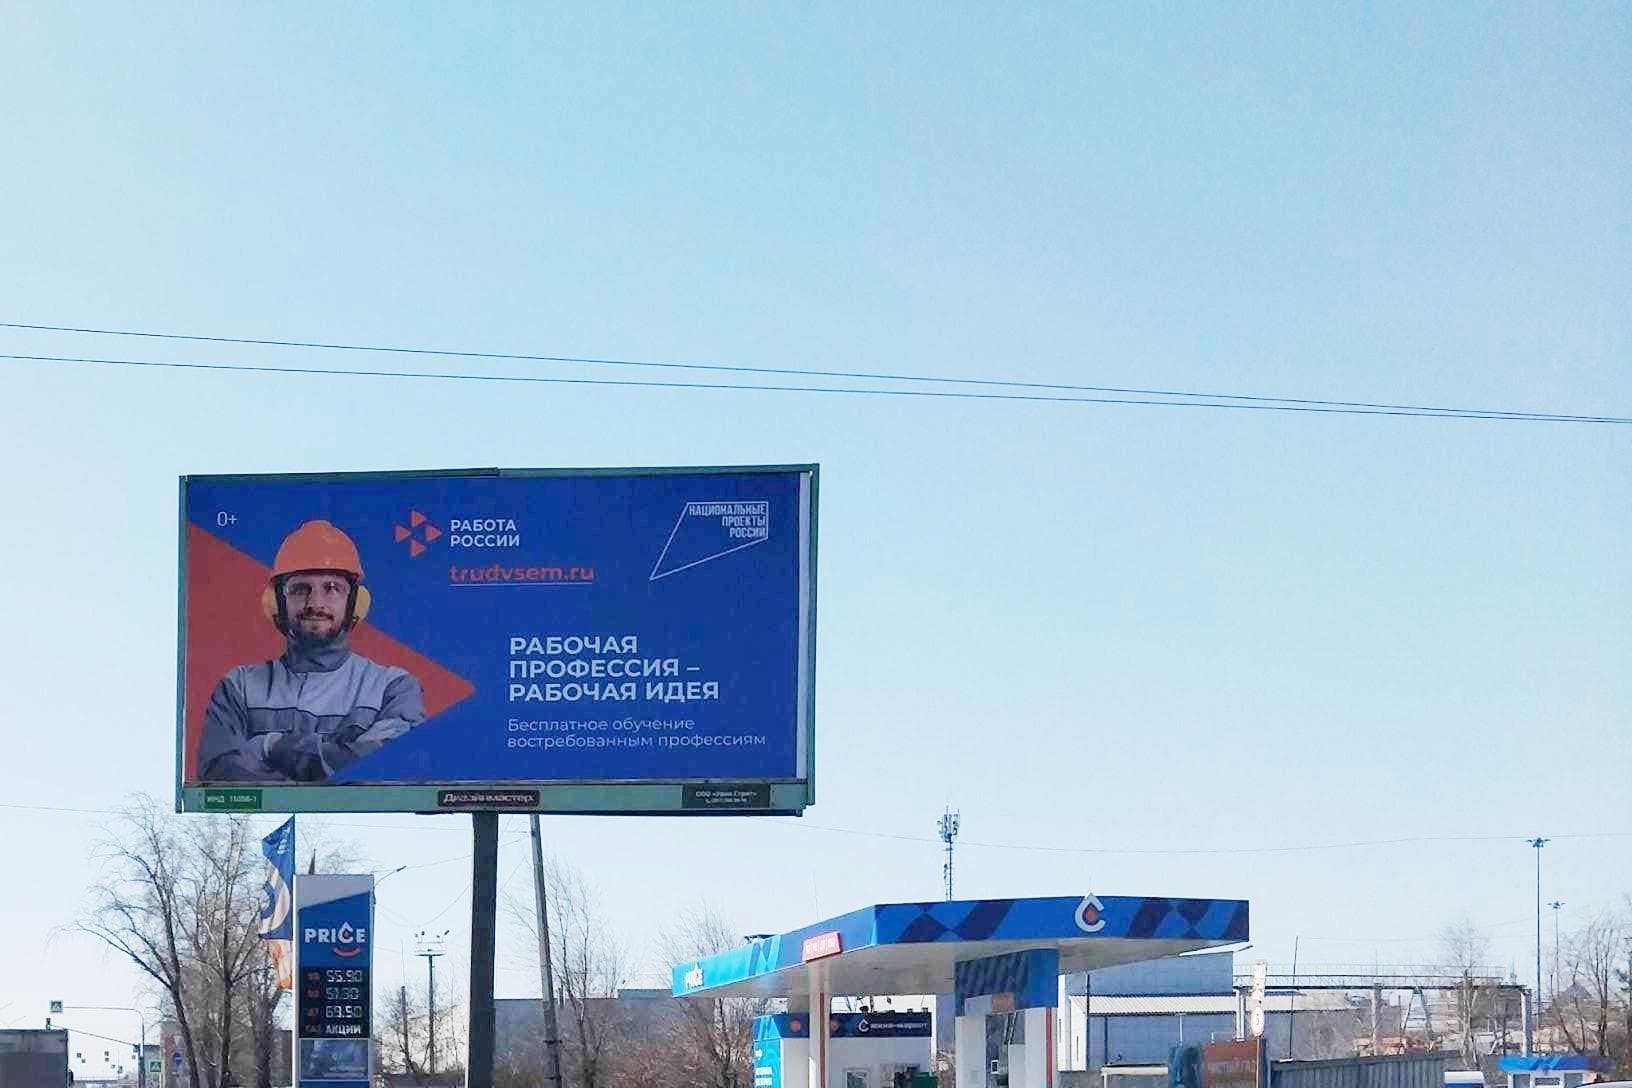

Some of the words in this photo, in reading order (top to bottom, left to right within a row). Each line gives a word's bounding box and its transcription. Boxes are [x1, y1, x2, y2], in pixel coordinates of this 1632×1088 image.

[689, 504, 766, 516] НАЦИОНАЛЬНЫЕ
[217, 511, 238, 527] 0+
[450, 519, 517, 532] РАБОТА
[722, 516, 766, 527] ПРОЕКТЫ
[450, 534, 520, 547] РОССИИ
[729, 527, 766, 538] РОССИИ
[449, 564, 595, 581] trudvsem.ru
[509, 636, 638, 655] РАБОЧАЯ
[509, 658, 679, 678] ПРОФЕССИЯ
[509, 683, 637, 702] РАБОЧАЯ
[645, 681, 719, 703] ИДЕЯ
[508, 719, 609, 732] Бесплатное
[612, 717, 696, 733] обучение
[507, 734, 653, 750] востребованным
[658, 734, 766, 748] профессиям
[304, 921, 367, 944] PRICE
